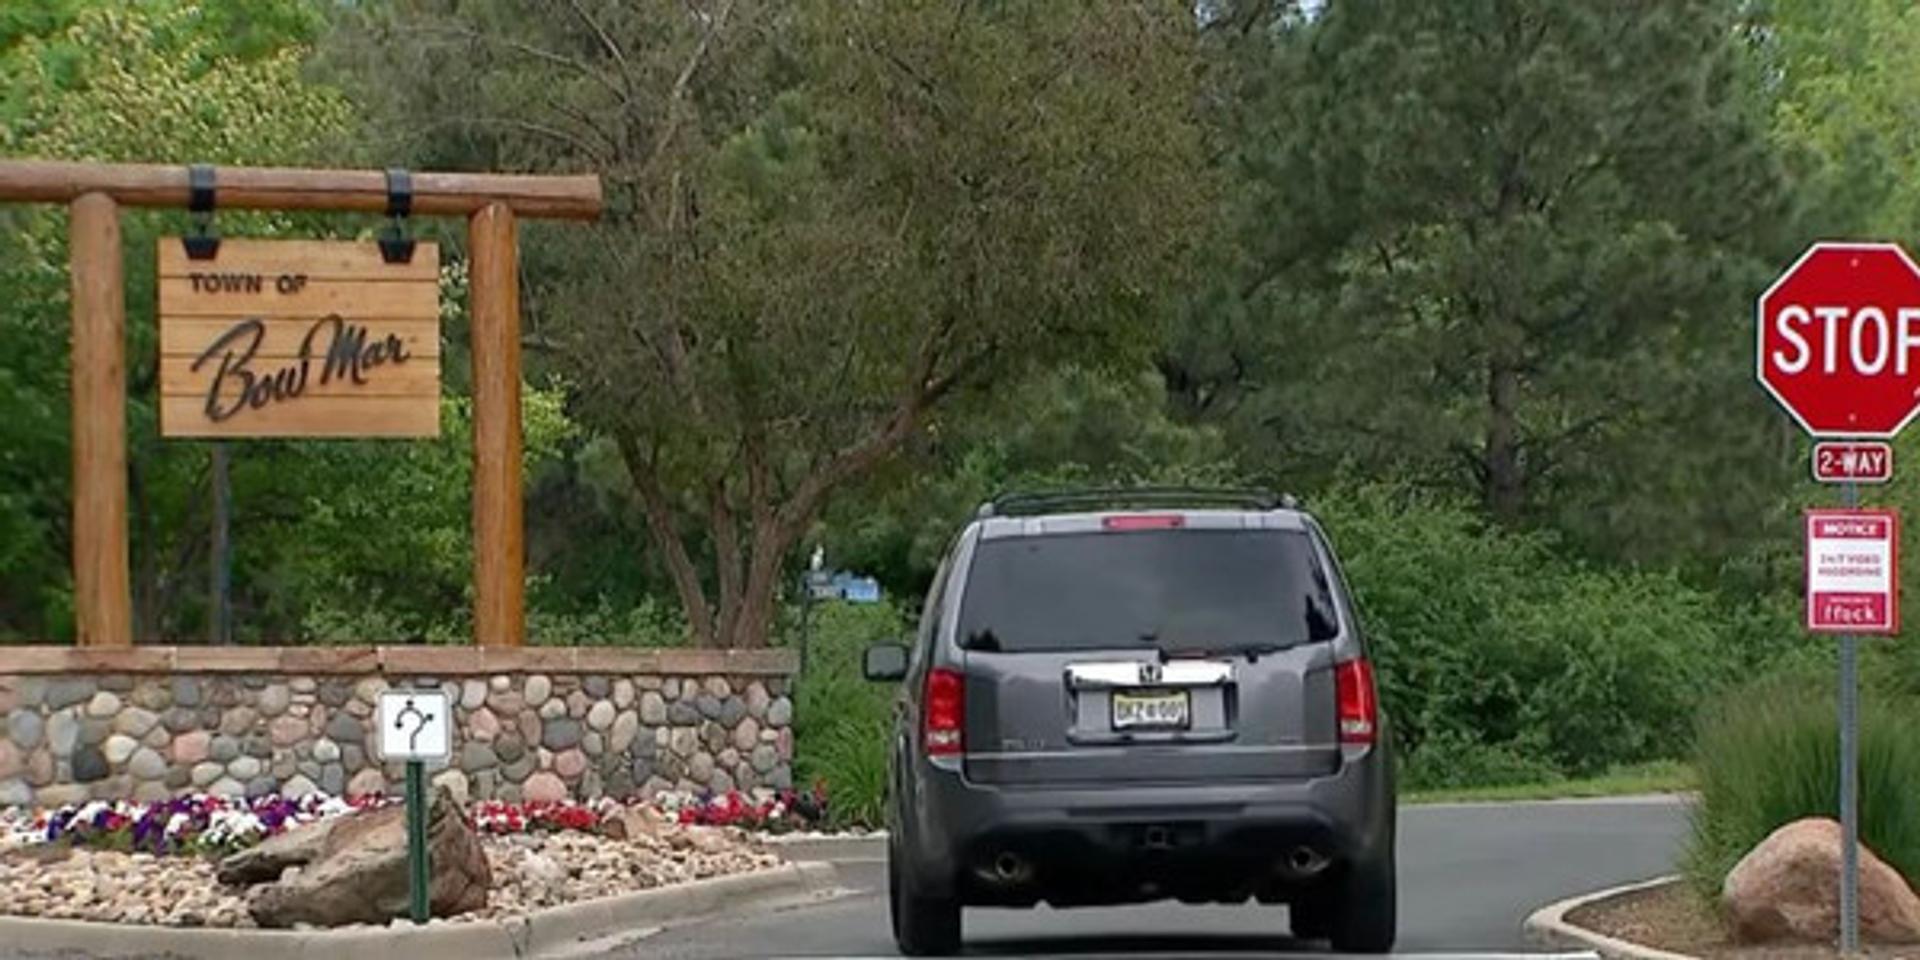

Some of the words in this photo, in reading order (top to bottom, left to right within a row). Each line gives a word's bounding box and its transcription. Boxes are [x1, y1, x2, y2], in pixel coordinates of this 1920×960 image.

[190, 273, 262, 293] TOWN
[276, 274, 307, 294] OF
[1773, 305, 1920, 375] STOP
[190, 318, 310, 422] Bow
[300, 314, 411, 386] Mar
[1820, 451, 1884, 473] 2-WAY
[1823, 523, 1876, 536] NOTICE
